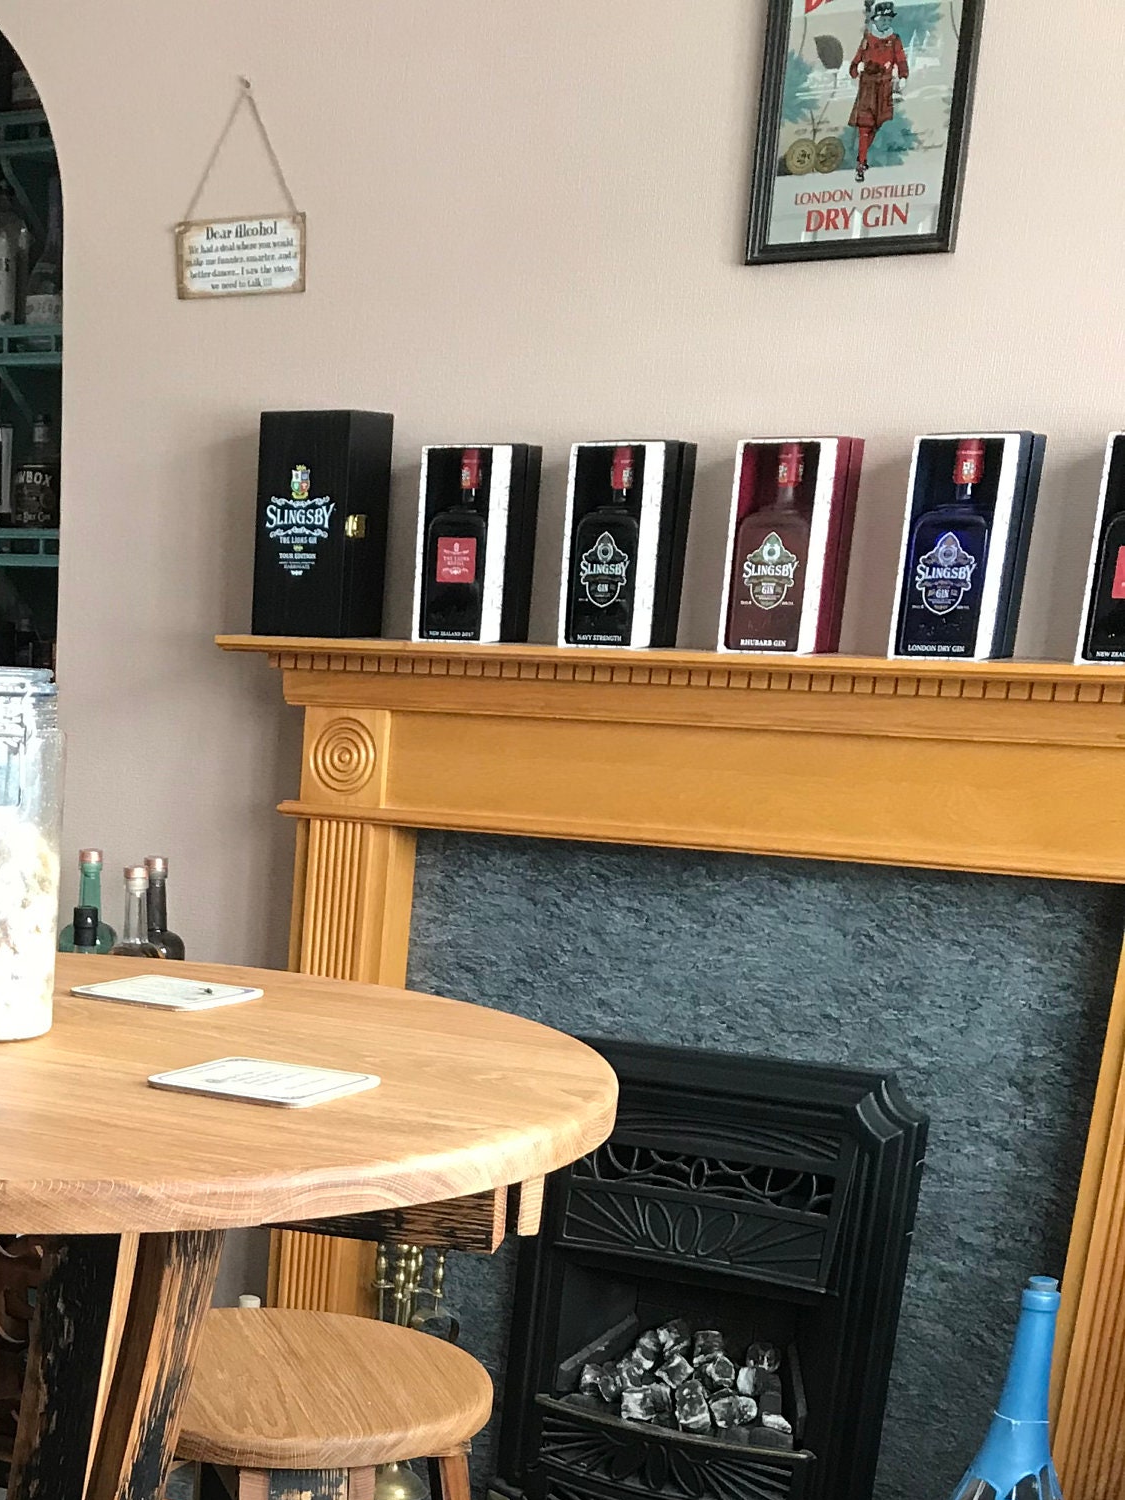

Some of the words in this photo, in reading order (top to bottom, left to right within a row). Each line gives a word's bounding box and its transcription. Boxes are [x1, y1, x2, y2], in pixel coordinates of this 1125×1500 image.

[794, 189, 853, 206] LONDON
[860, 183, 926, 200] DISTILLED
[805, 206, 856, 232] DRY
[862, 203, 910, 228] GIN
[205, 226, 233, 241] Dear
[234, 221, 278, 239] Alcohol
[272, 237, 294, 248] would
[17, 470, 53, 487] WBOX
[265, 502, 336, 529] SLINGSBY
[579, 560, 630, 577] SLINGSBY
[742, 561, 800, 579] SLINGSBY
[915, 563, 977, 582] SLINGSBY
[597, 583, 609, 593] GIN
[761, 585, 775, 594] GIN
[935, 588, 950, 599] GIN
[593, 634, 622, 642] STRENGTH
[740, 639, 773, 647] RHUBARB
[907, 644, 937, 652] LONDON
